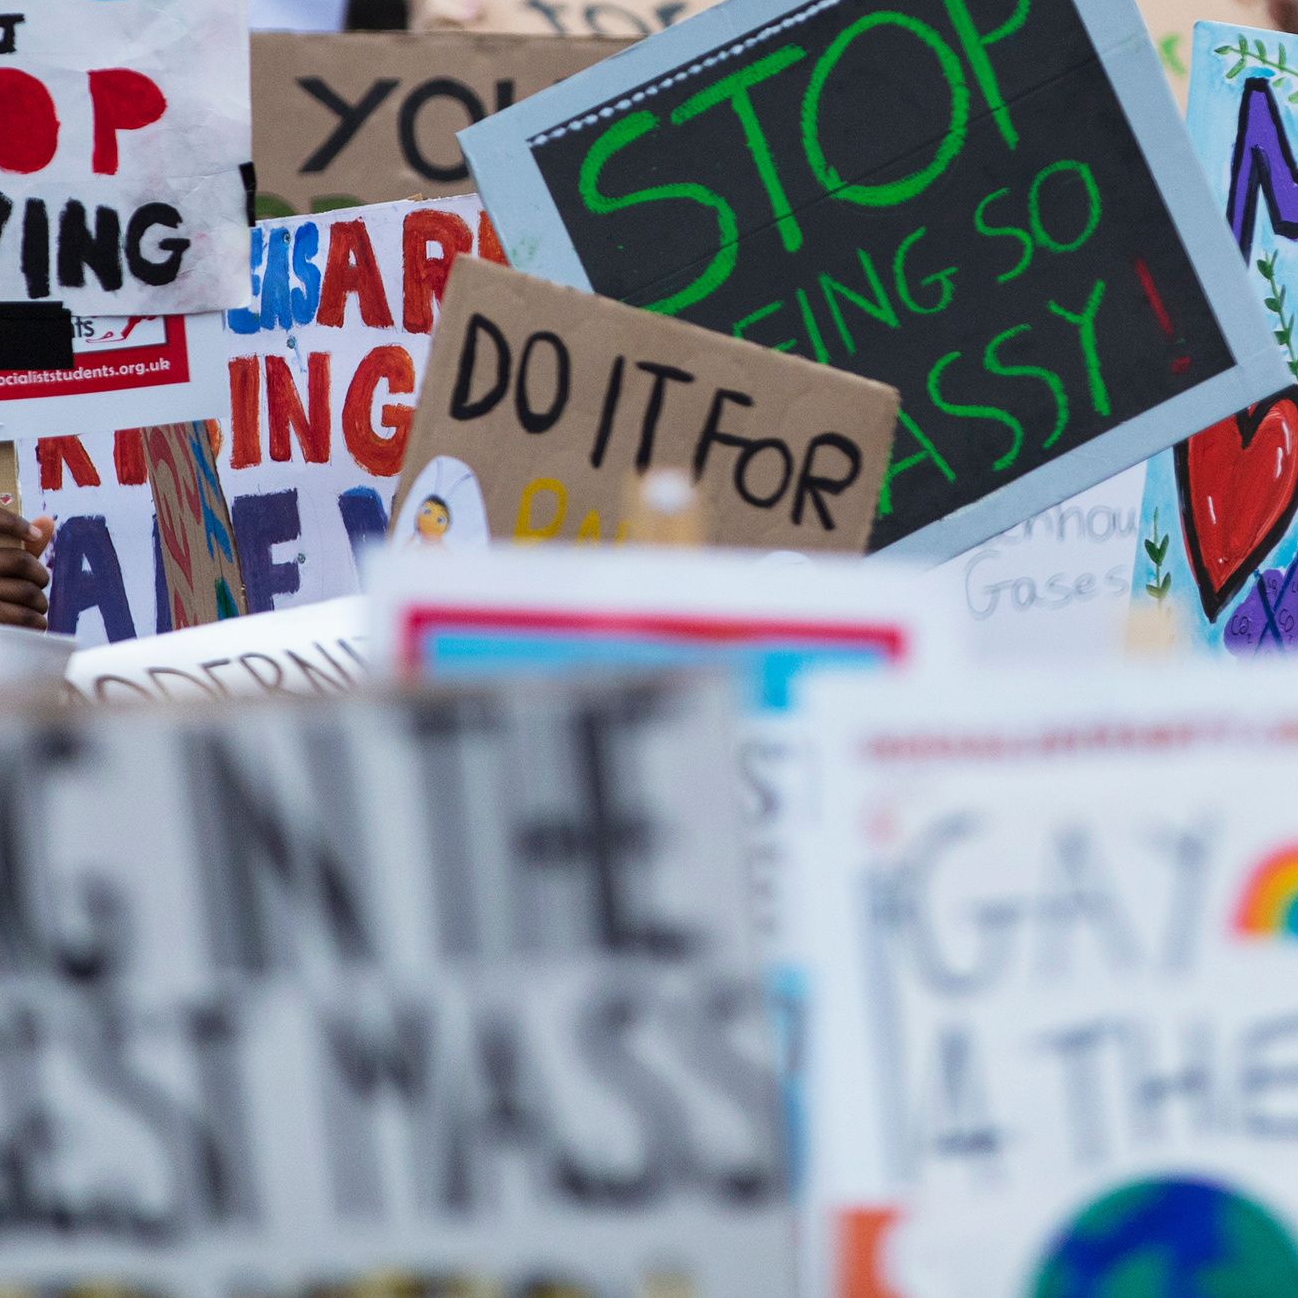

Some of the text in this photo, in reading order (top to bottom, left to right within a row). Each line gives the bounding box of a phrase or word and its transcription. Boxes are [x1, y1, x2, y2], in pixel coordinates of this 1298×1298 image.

[296, 75, 516, 184] YO
[973, 159, 1102, 282] SO
[451, 312, 572, 434] DO
[589, 355, 695, 476] IT
[693, 388, 862, 531] FOR
